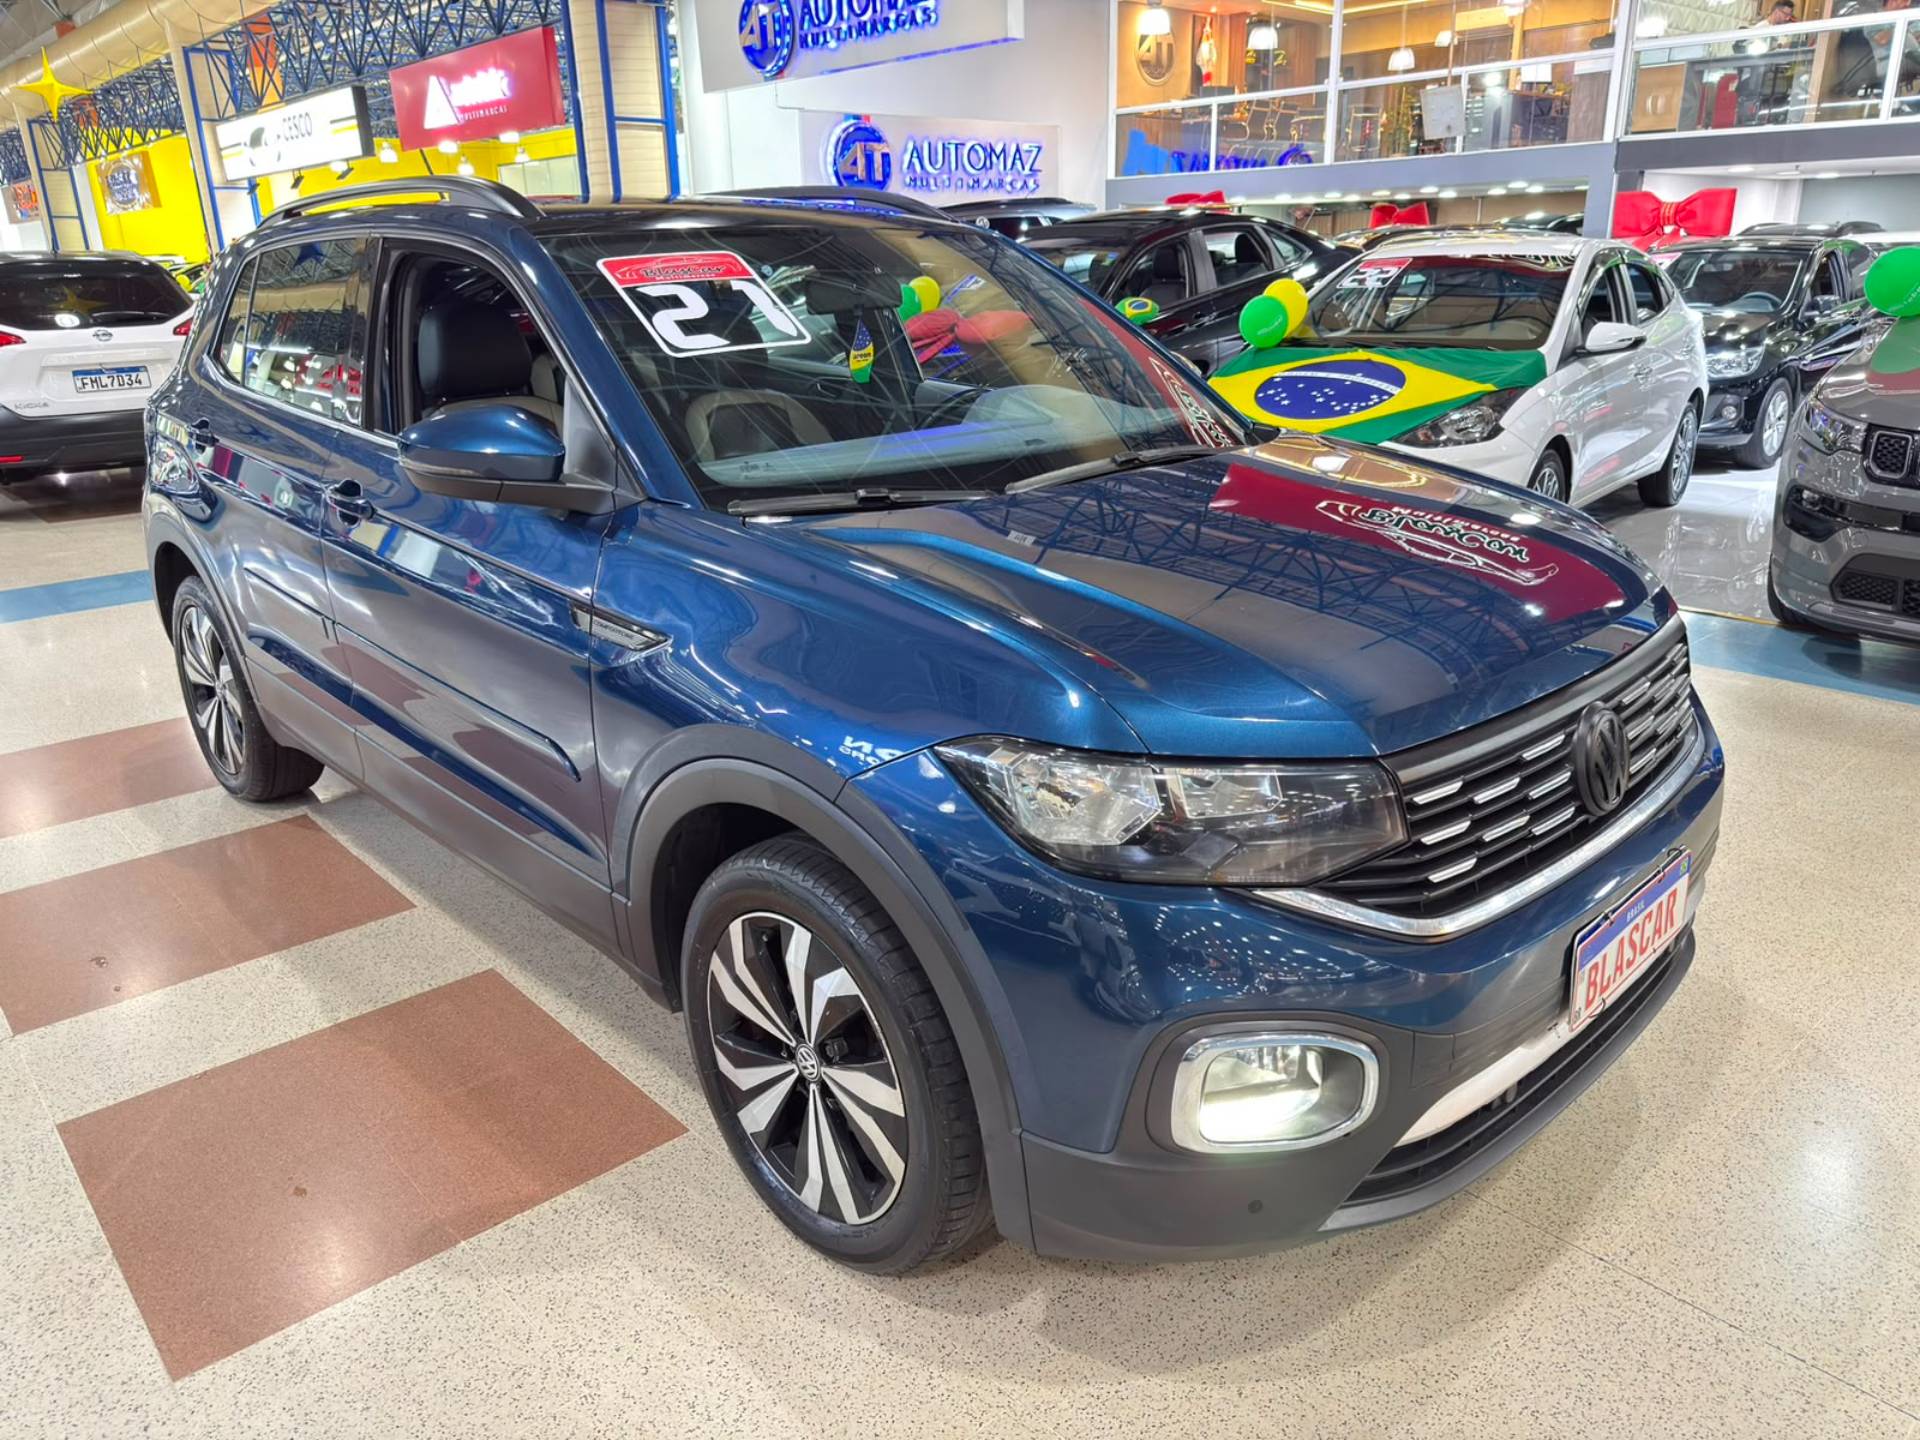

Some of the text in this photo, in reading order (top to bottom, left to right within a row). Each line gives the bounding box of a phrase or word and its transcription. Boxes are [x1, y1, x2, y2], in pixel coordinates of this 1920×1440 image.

[799, 7, 937, 49] MULTIMARCAS
[903, 139, 1043, 174] AUTOMAZ
[904, 175, 1040, 193] MULTIMARCAS
[635, 279, 799, 350] 21
[80, 373, 143, 390] FML7D34
[1626, 900, 1646, 923] BRASIL
[1585, 887, 1678, 1012] BLASCAR
